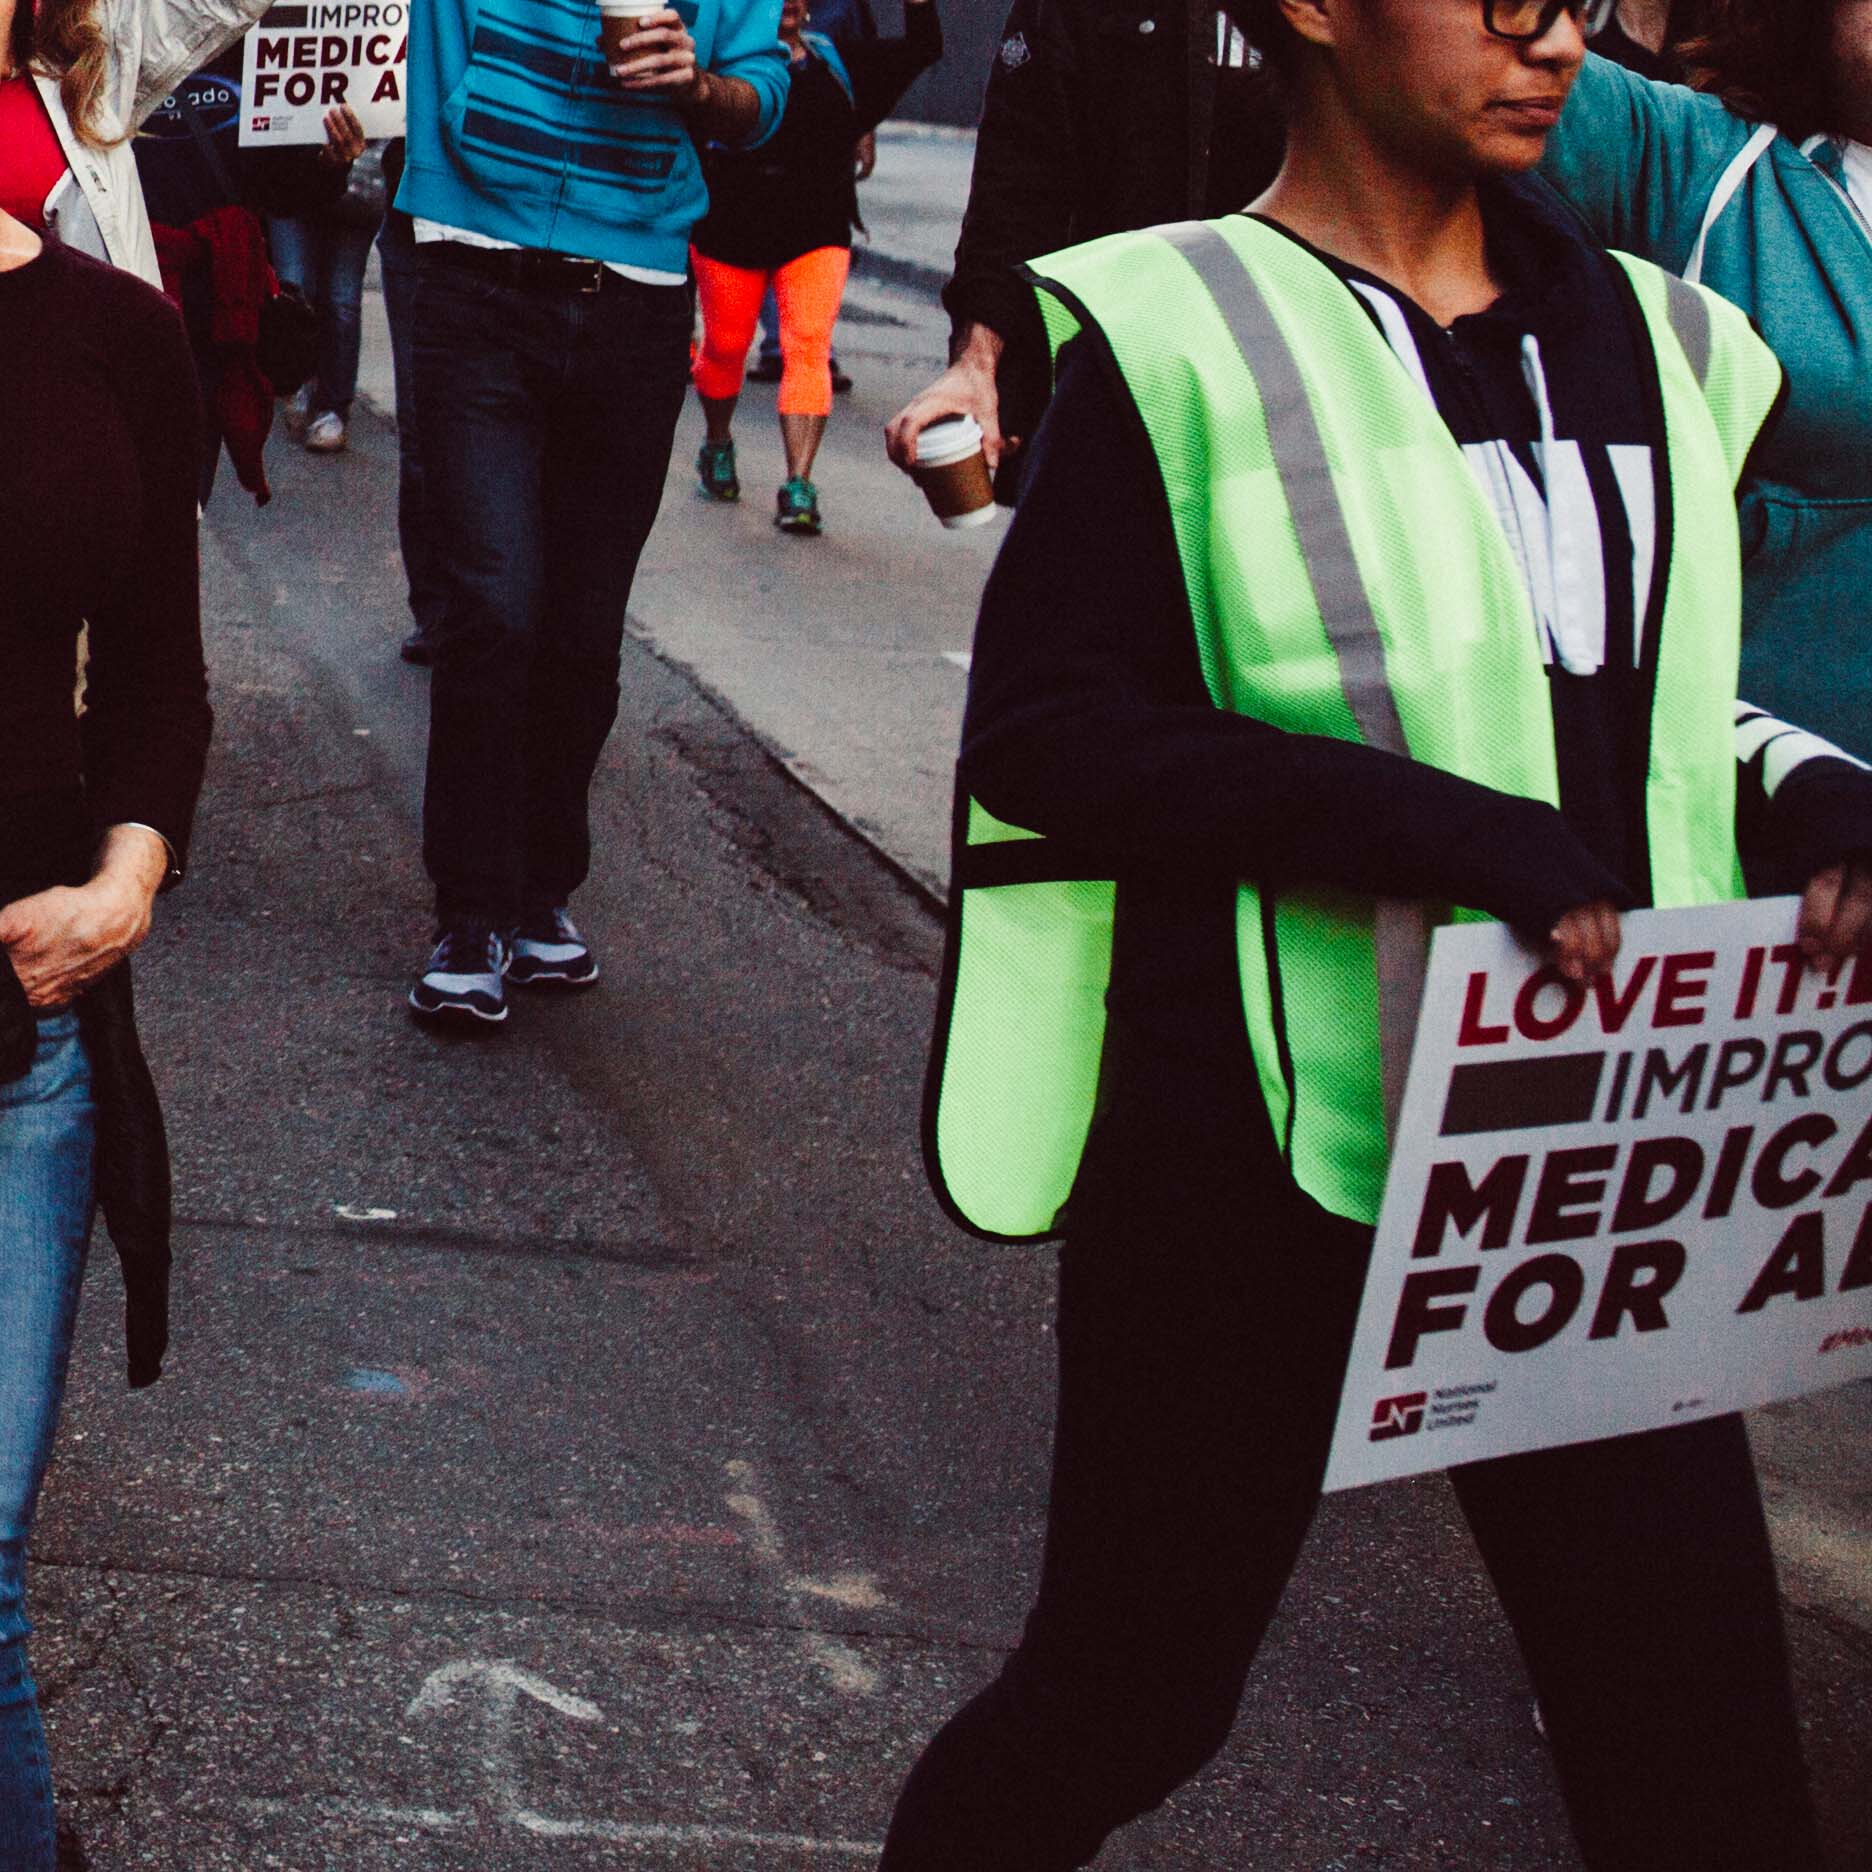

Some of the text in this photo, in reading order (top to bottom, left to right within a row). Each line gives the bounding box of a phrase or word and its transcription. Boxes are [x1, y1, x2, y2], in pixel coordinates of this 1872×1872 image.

[311, 4, 408, 28] IMPRO
[256, 34, 407, 69] MEDIC
[254, 72, 349, 107] FOR
[1457, 950, 1716, 1047] LOVE
[1604, 1019, 1872, 1123] IMPRO
[1383, 1238, 1686, 1371] FOR
